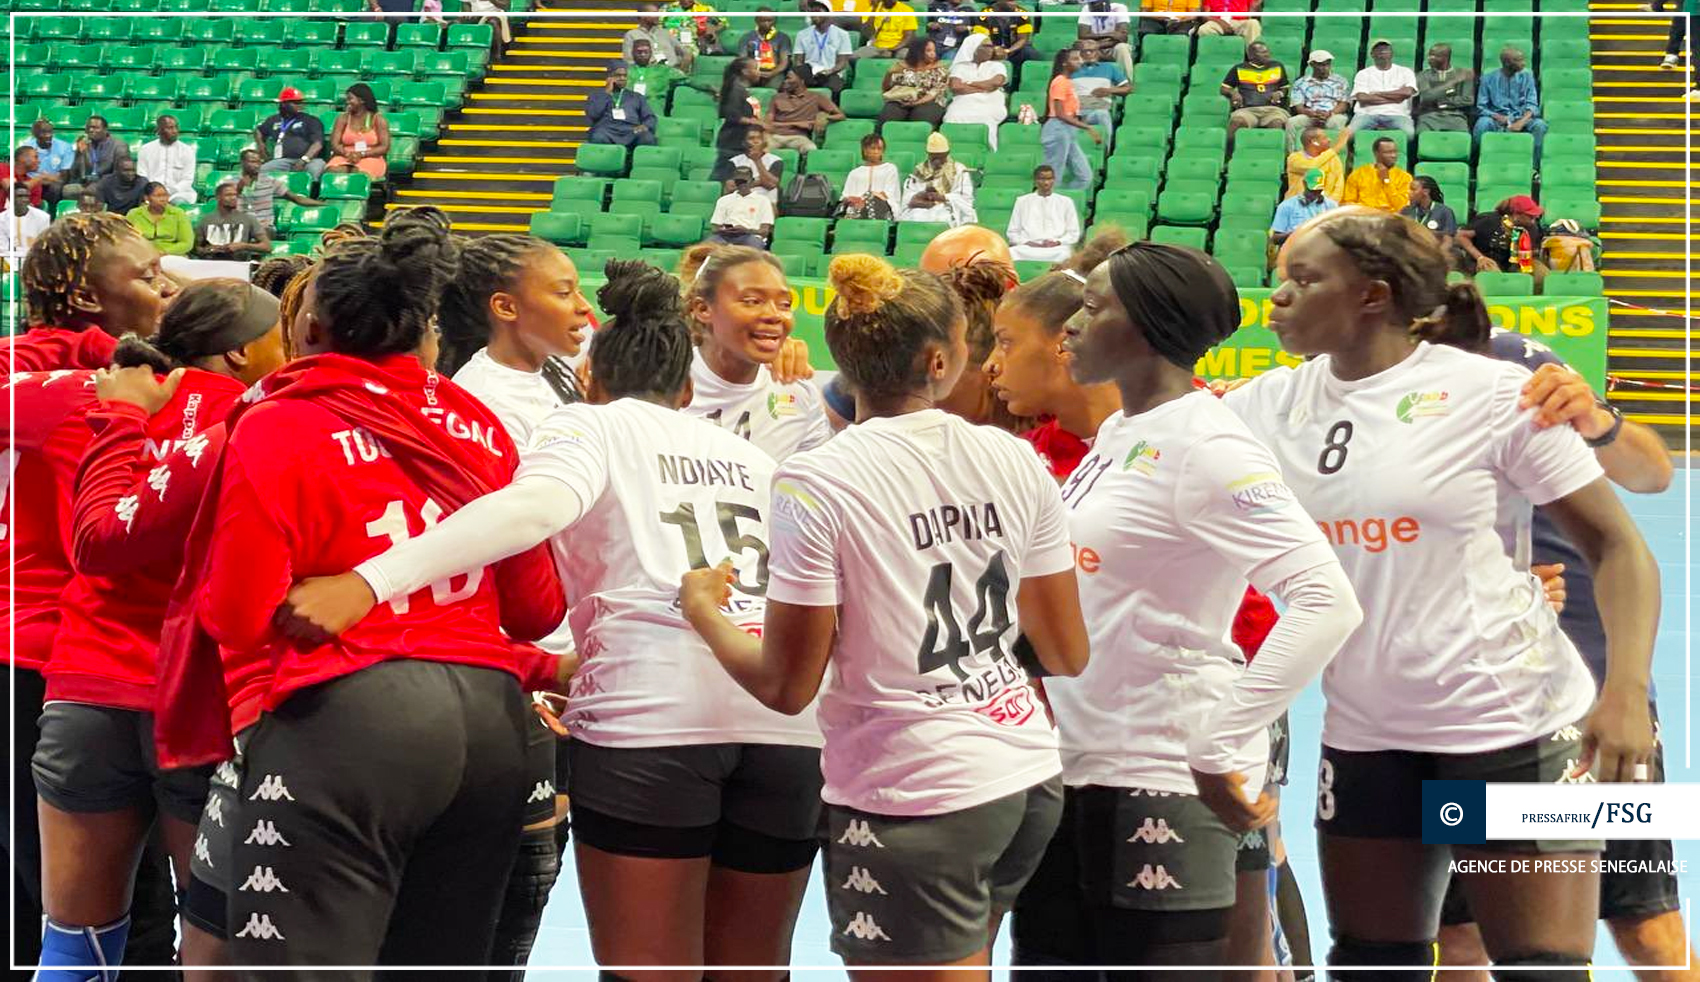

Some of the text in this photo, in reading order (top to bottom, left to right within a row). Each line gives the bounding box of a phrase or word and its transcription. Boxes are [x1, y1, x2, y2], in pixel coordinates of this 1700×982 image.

[657, 453, 755, 492] NDIAYE
[1317, 420, 1354, 475] 8
[1061, 453, 1114, 510] 91
[659, 501, 769, 597] 15
[918, 549, 1016, 683] 44
[1318, 758, 1335, 820] 8
